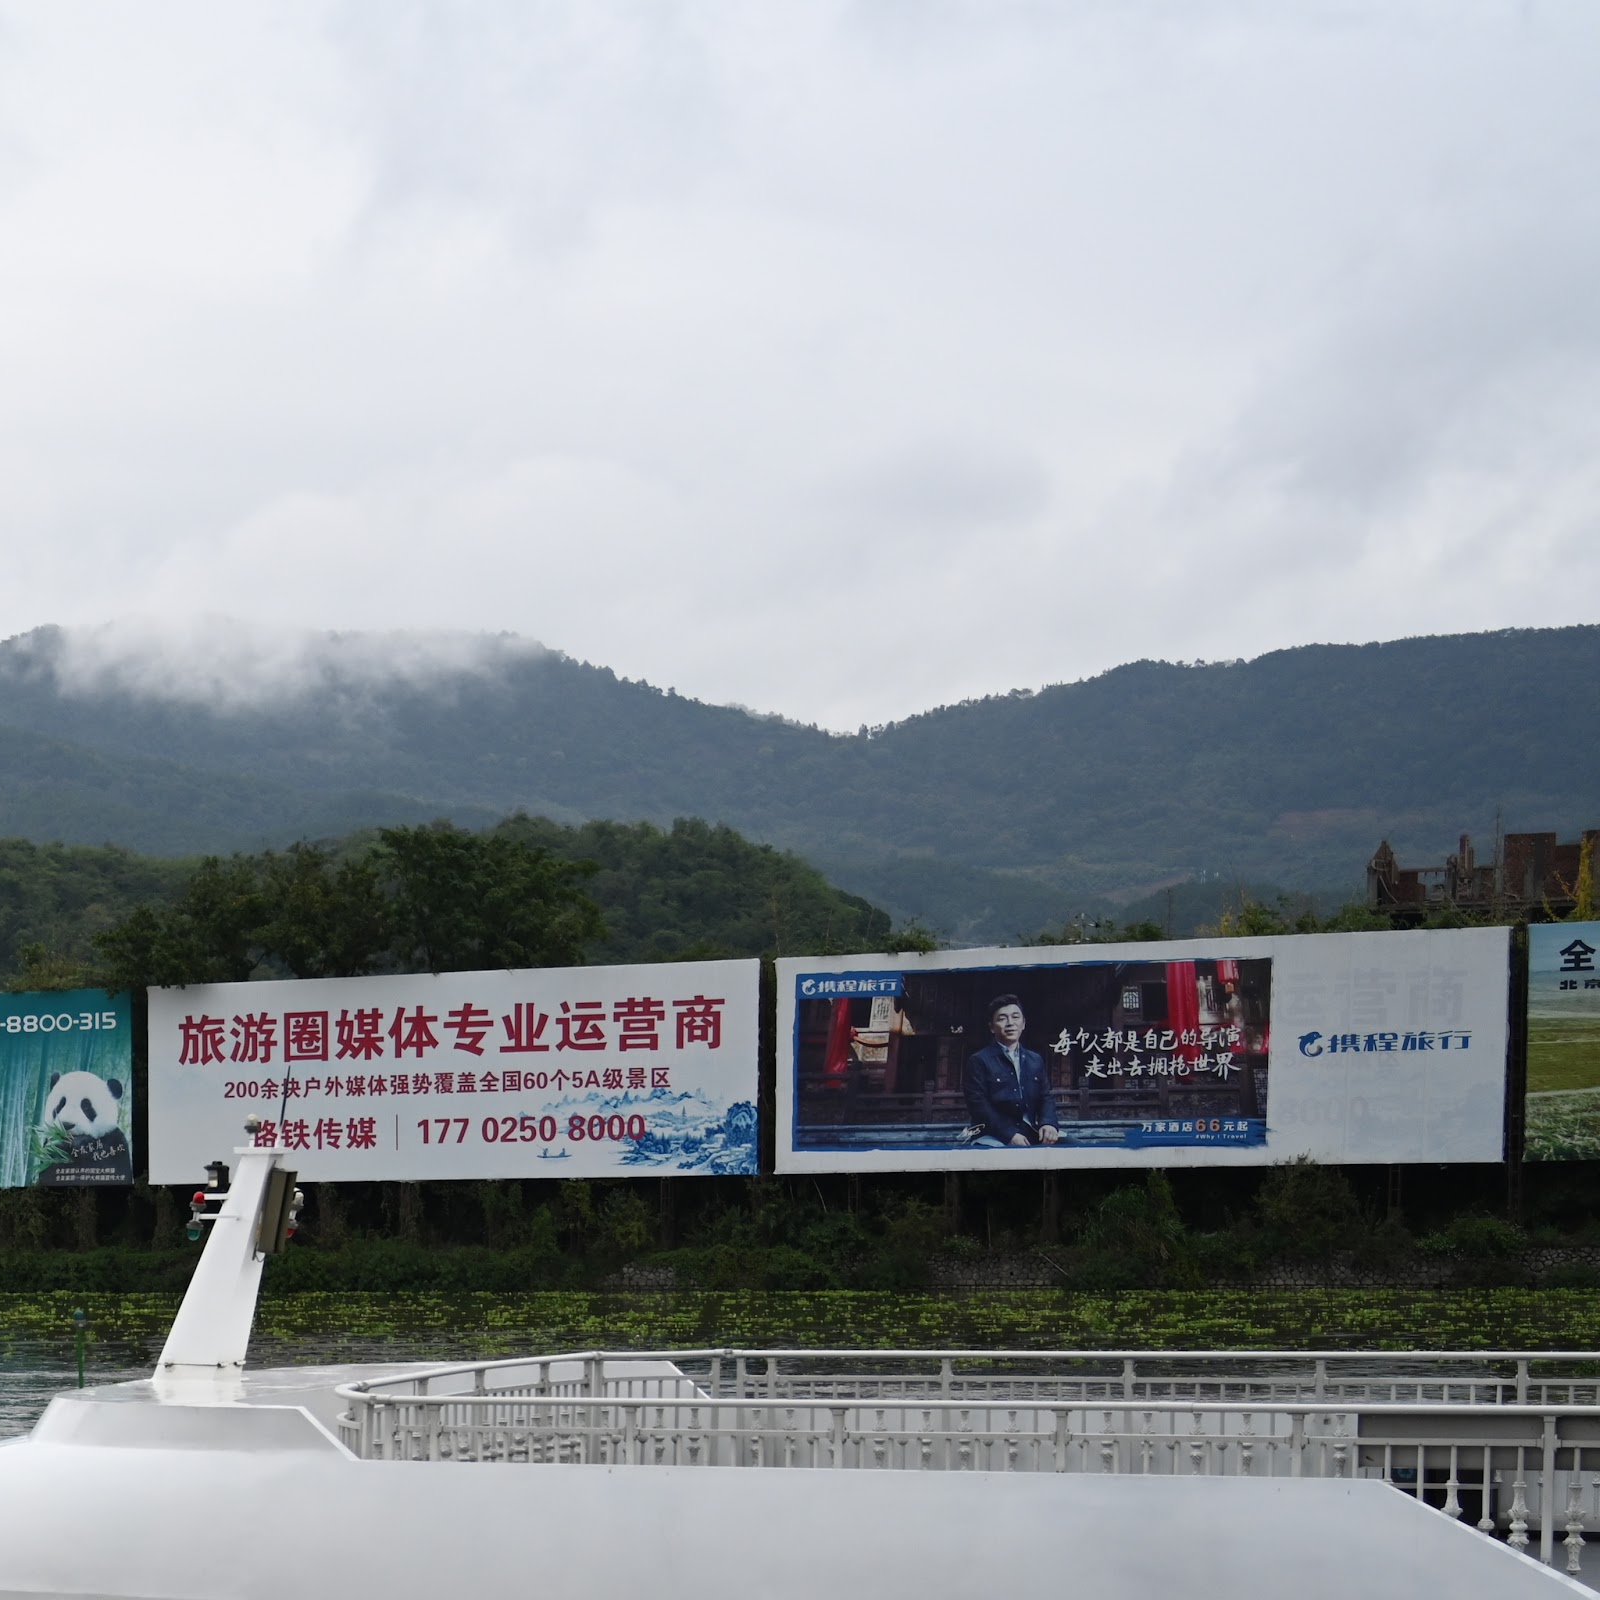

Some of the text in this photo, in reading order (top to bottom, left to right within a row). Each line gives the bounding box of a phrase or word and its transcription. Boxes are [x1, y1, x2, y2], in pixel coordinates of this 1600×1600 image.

[1559, 939, 1597, 972] 全
[817, 979, 898, 993] 携程旅行
[178, 995, 725, 1066] 旅游圈媒体专业运营商
[1049, 1025, 1242, 1056] 每个人都是自己的导演
[1327, 1030, 1472, 1054] 携程旅行
[1084, 1052, 1242, 1081] 走出去拥抱世界
[224, 1067, 672, 1099] 200余块户外媒体强势覆盖全国60个5A级景区
[417, 1118, 470, 1144] 177
[481, 1115, 557, 1143] 0250
[567, 1114, 646, 1141] 8000
